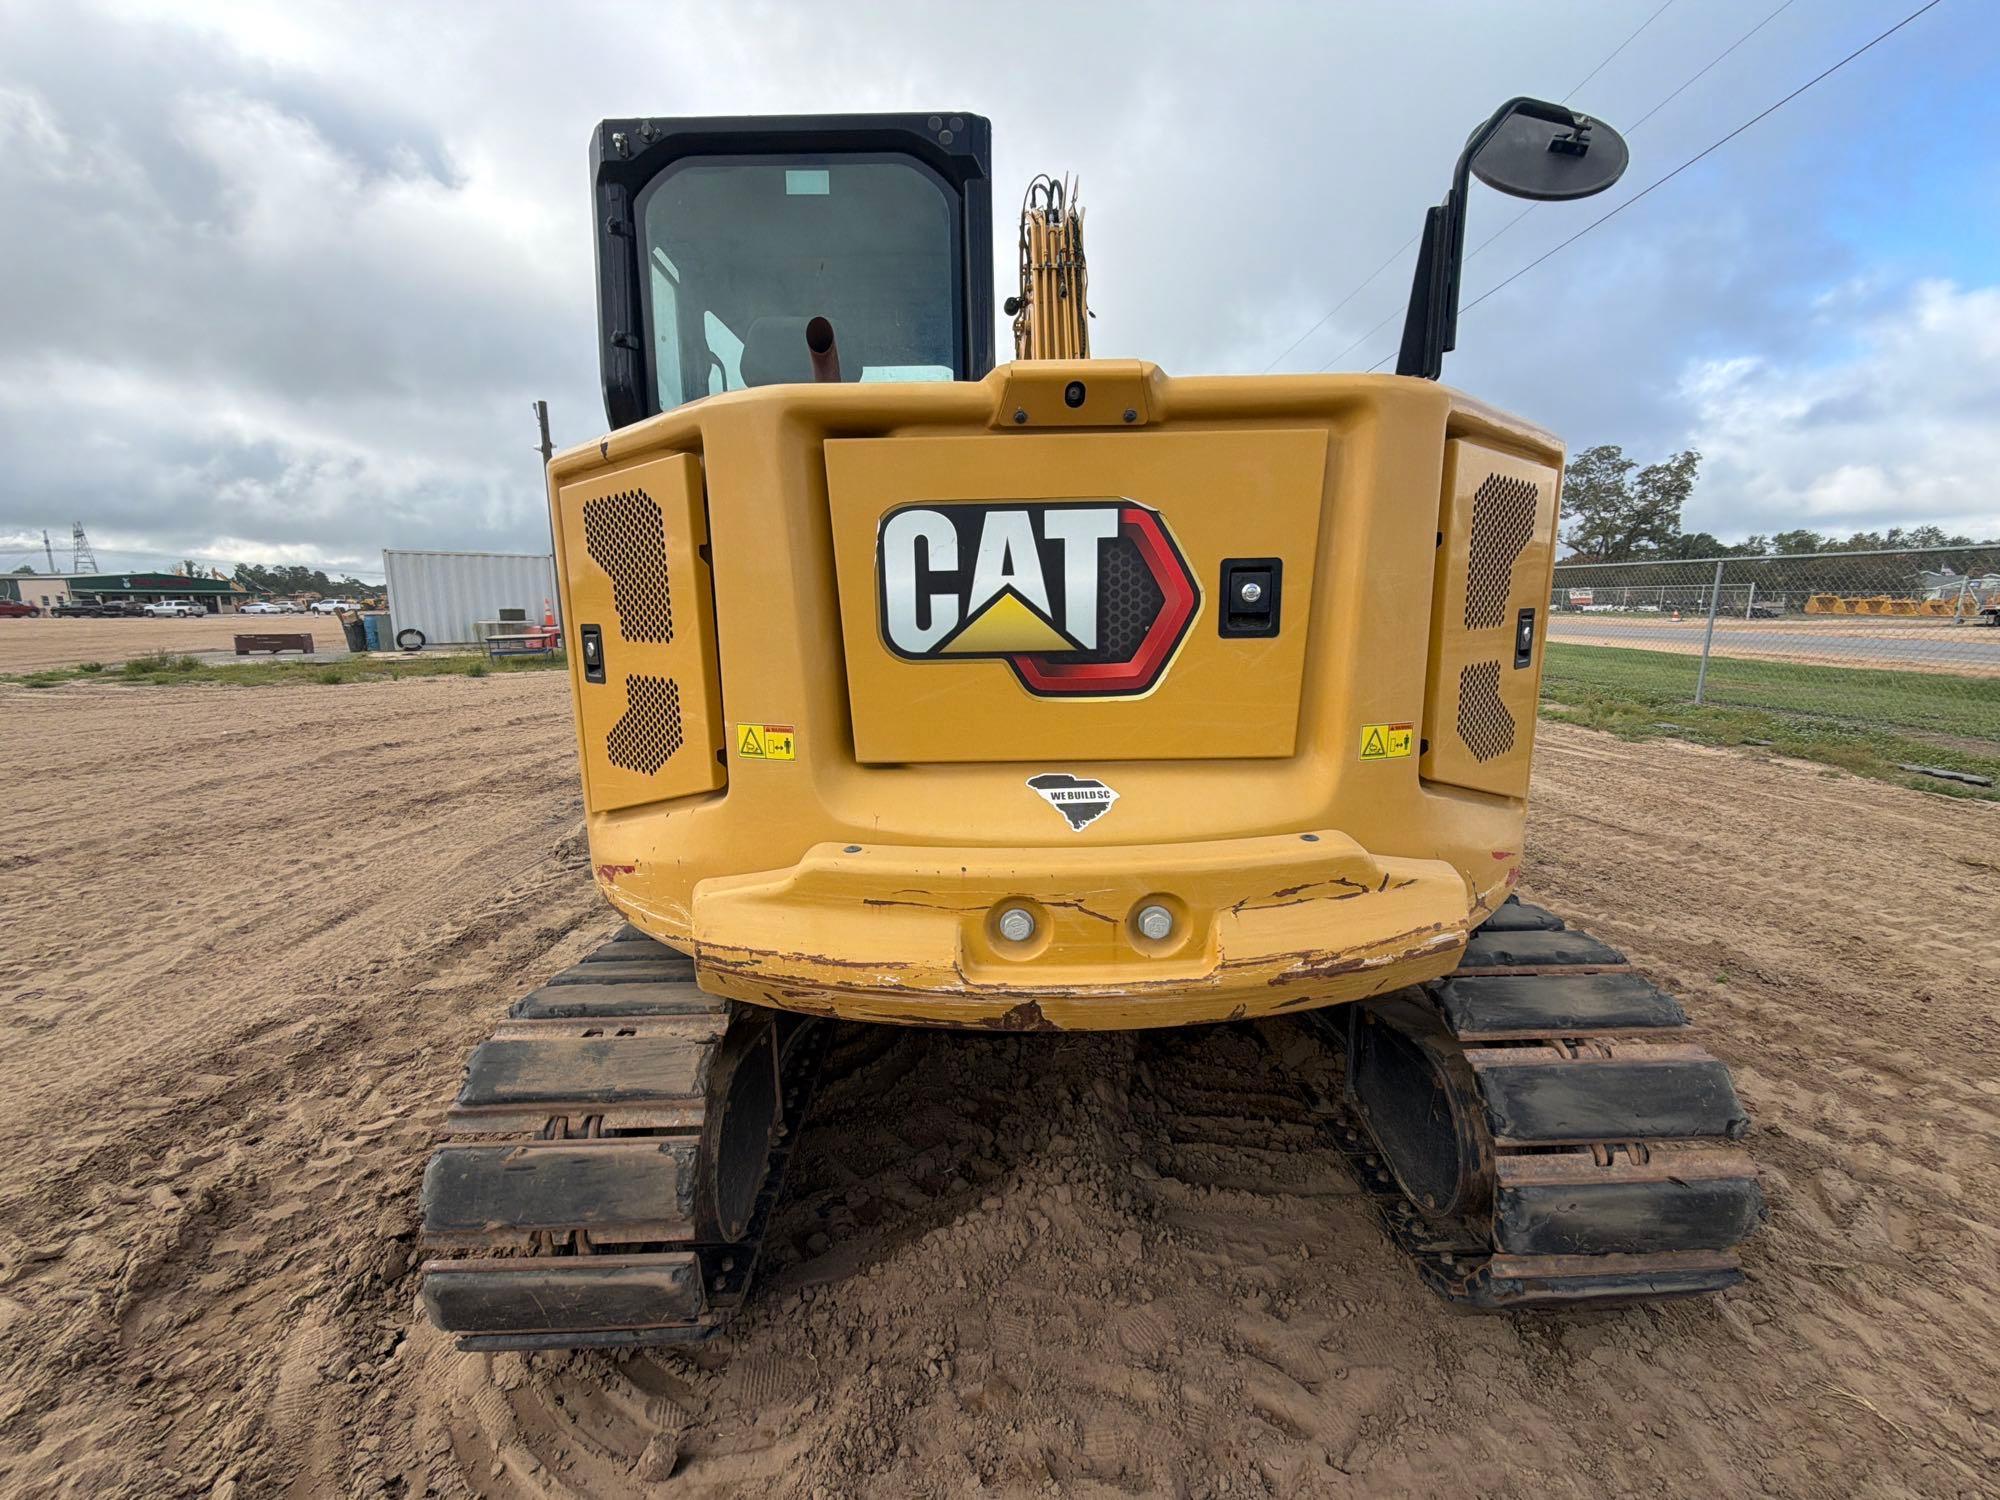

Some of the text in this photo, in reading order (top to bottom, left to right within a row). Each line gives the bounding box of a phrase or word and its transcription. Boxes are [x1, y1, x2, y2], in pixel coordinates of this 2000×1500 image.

[884, 508, 1119, 653] CAT
[1050, 790, 1110, 801] WE BUILD SC
